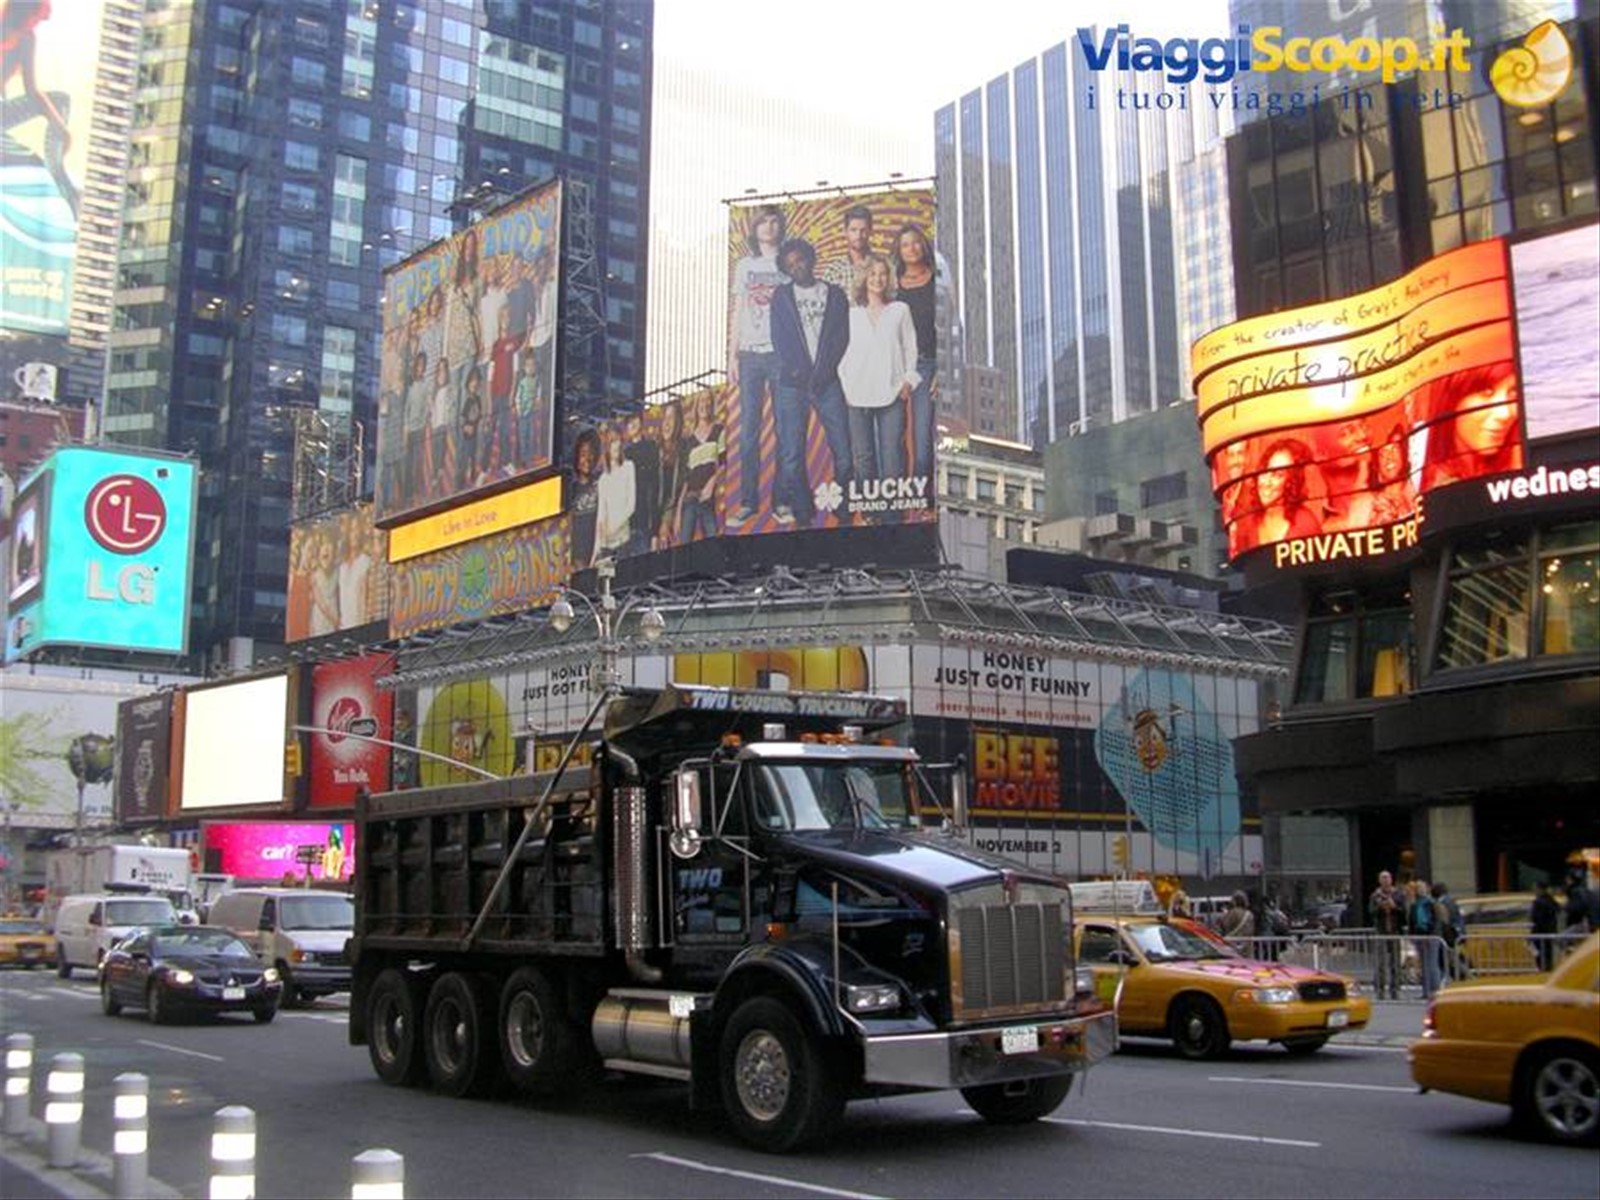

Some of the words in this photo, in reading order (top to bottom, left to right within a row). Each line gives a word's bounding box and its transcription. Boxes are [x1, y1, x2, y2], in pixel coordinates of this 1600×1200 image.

[1234, 331, 1253, 346] the
[1264, 319, 1324, 340] creator
[1333, 308, 1348, 326] of
[1227, 351, 1322, 420] private
[848, 476, 928, 500] LUCKY
[1486, 465, 1600, 503] wednes
[848, 500, 888, 513] BRAND
[889, 498, 928, 511] JEANS
[1275, 528, 1386, 569] PRIVATE
[87, 560, 155, 605] LG
[551, 661, 591, 681] HONEY
[983, 652, 1046, 673] HONEY
[523, 684, 548, 700] JUST
[552, 681, 576, 696] GOT
[934, 667, 980, 686] JUST
[986, 673, 1024, 691] GOT
[1031, 677, 1091, 697] FUNNY
[691, 690, 728, 709] TWO
[974, 731, 1060, 780] BEE
[977, 781, 1062, 808] MOVIE
[976, 839, 1049, 853] NOVEMBER
[1052, 841, 1062, 854] 2
[679, 867, 722, 888] TWO
